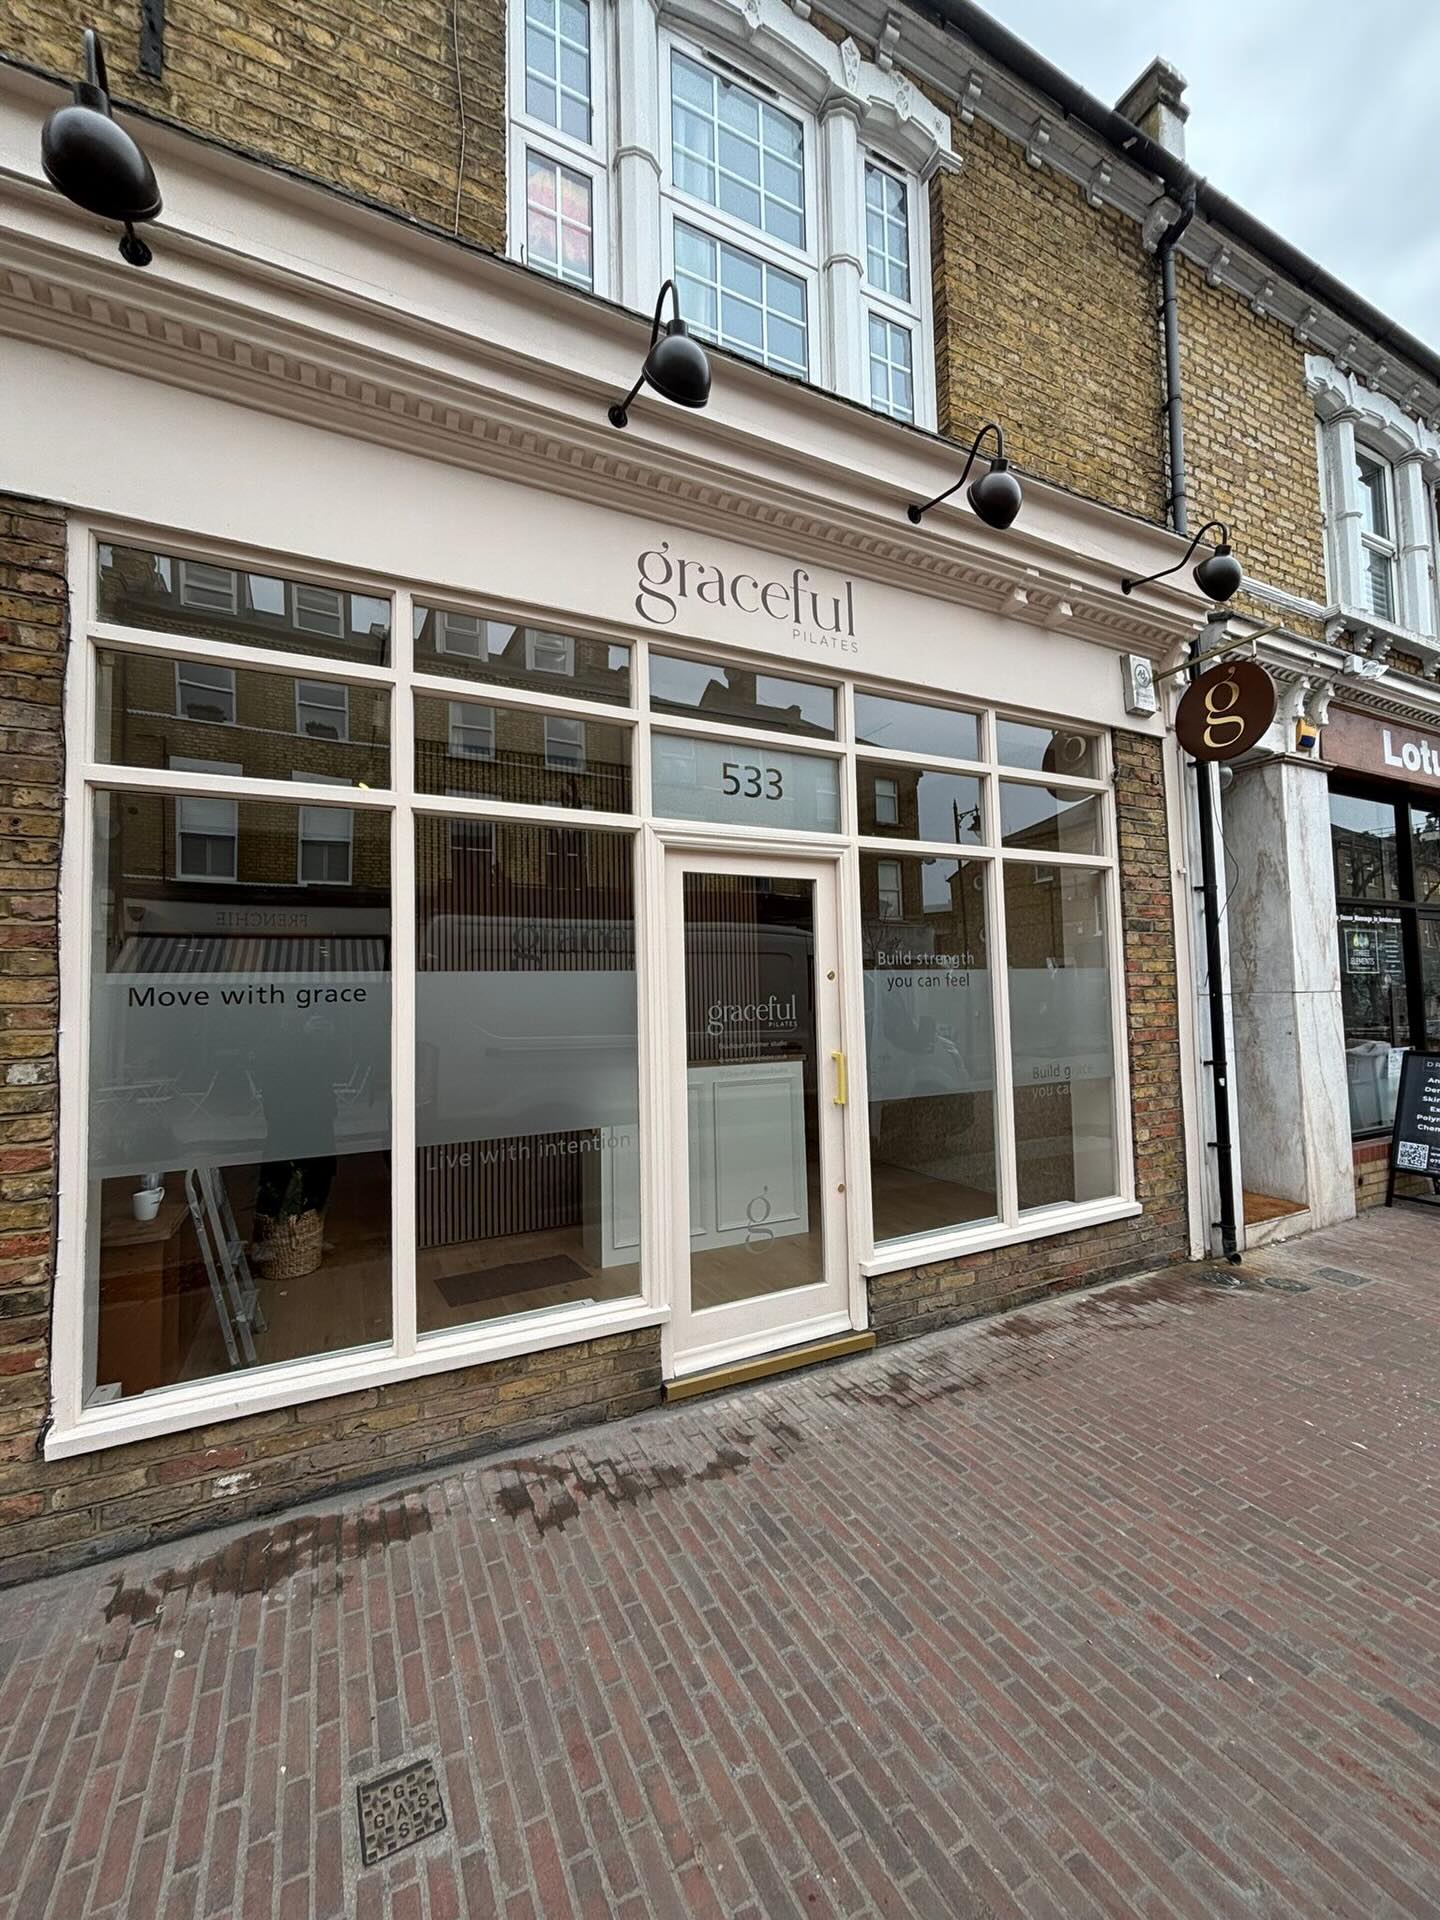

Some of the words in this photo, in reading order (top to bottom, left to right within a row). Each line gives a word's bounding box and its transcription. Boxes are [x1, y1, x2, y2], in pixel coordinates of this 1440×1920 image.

[635, 541, 856, 636] graceful
[792, 628, 859, 653] PILATES
[1203, 666, 1245, 748] g
[723, 762, 783, 800] 533
[878, 951, 912, 967] Build
[917, 951, 975, 969] strength
[887, 976, 912, 992] you
[918, 975, 940, 988] can
[946, 972, 970, 988] feel
[128, 987, 210, 1008] Move
[221, 984, 285, 1005] with
[296, 987, 367, 1008] grace
[708, 994, 797, 1036] graceful
[768, 1020, 798, 1028] PILATES
[1032, 1064, 1060, 1080] Build
[1032, 1086, 1053, 1102] you
[427, 1151, 472, 1171] Live
[480, 1142, 531, 1165] with
[539, 1134, 631, 1158] intention
